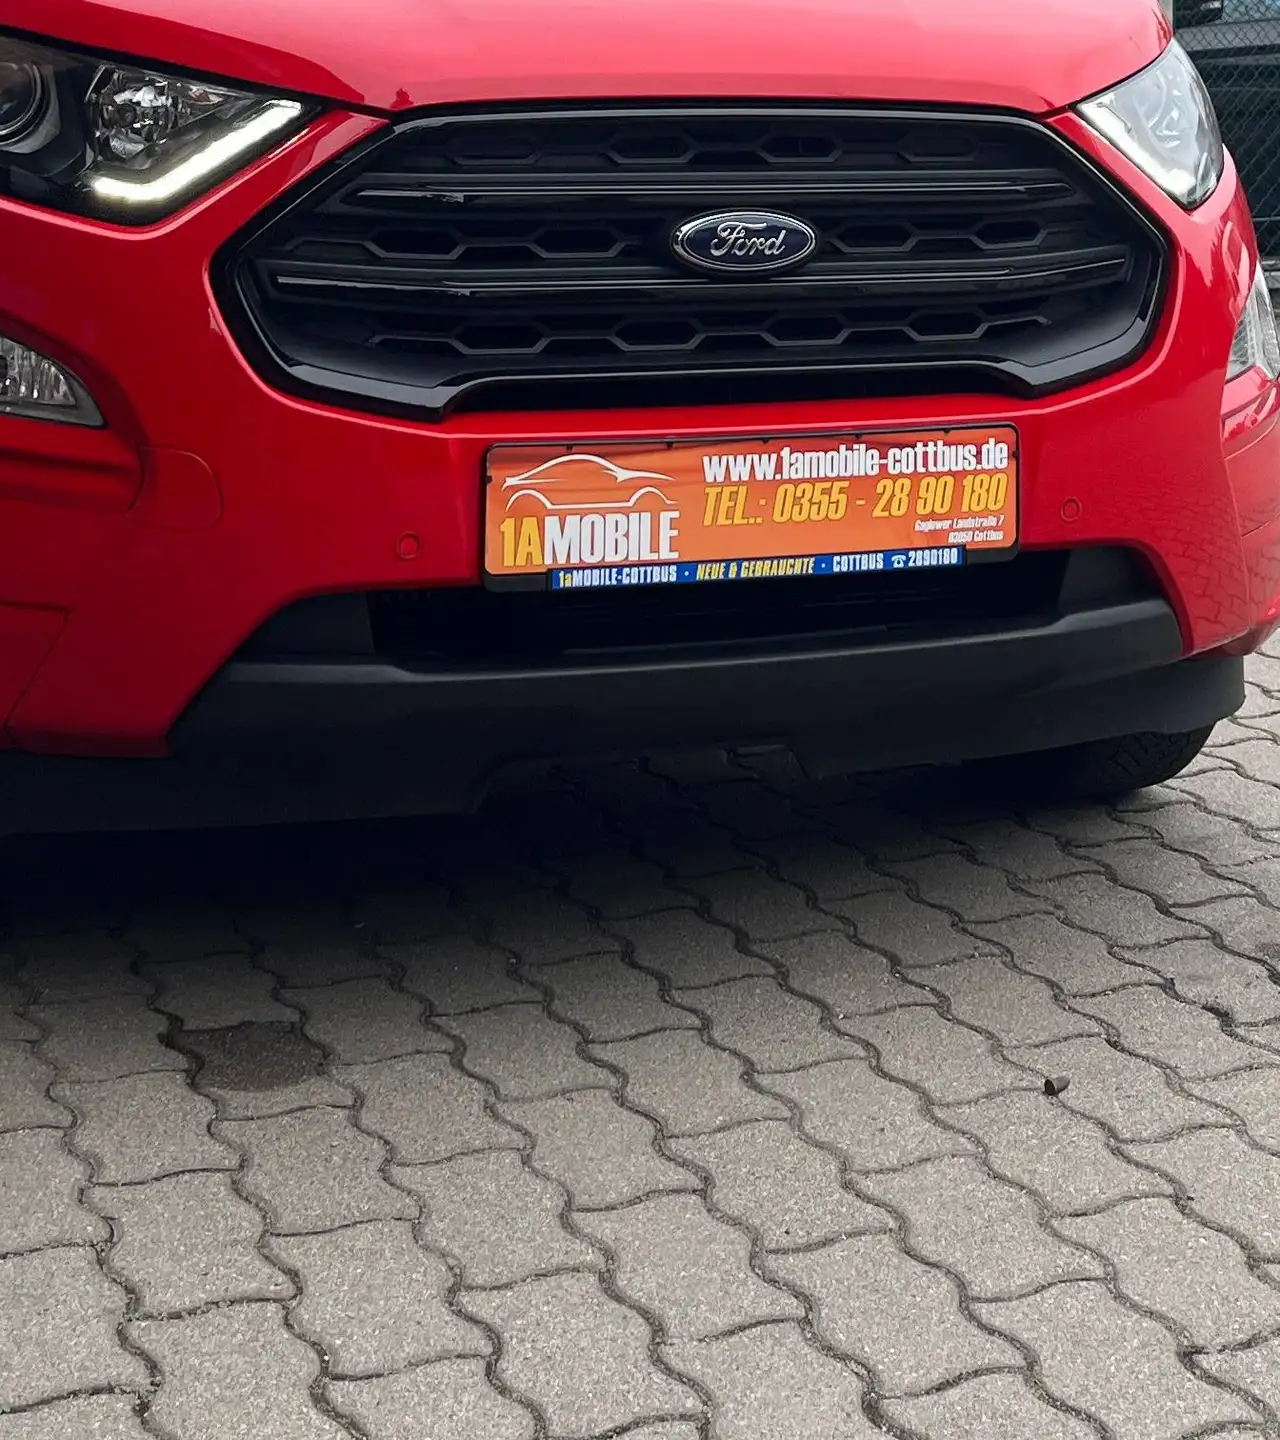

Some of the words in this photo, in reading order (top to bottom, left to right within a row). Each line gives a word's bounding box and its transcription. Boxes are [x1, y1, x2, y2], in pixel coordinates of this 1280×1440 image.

[710, 221, 786, 257] Ford
[702, 437, 1009, 483] www.1amobile-cottbus.de
[772, 481, 851, 523] 0355
[872, 477, 912, 518] 28
[916, 474, 955, 516] 90
[961, 472, 1008, 514] 180
[500, 510, 680, 567] 1AMOBILE
[973, 530, 1005, 543] Cottbus
[559, 564, 677, 588] 1aMOBILE-COTTBUS
[696, 561, 726, 581] NEUE
[728, 561, 738, 579] &
[740, 557, 816, 578] GEBRAUCHTE
[832, 552, 884, 573] COTTBUS
[908, 547, 959, 567] 2890180
